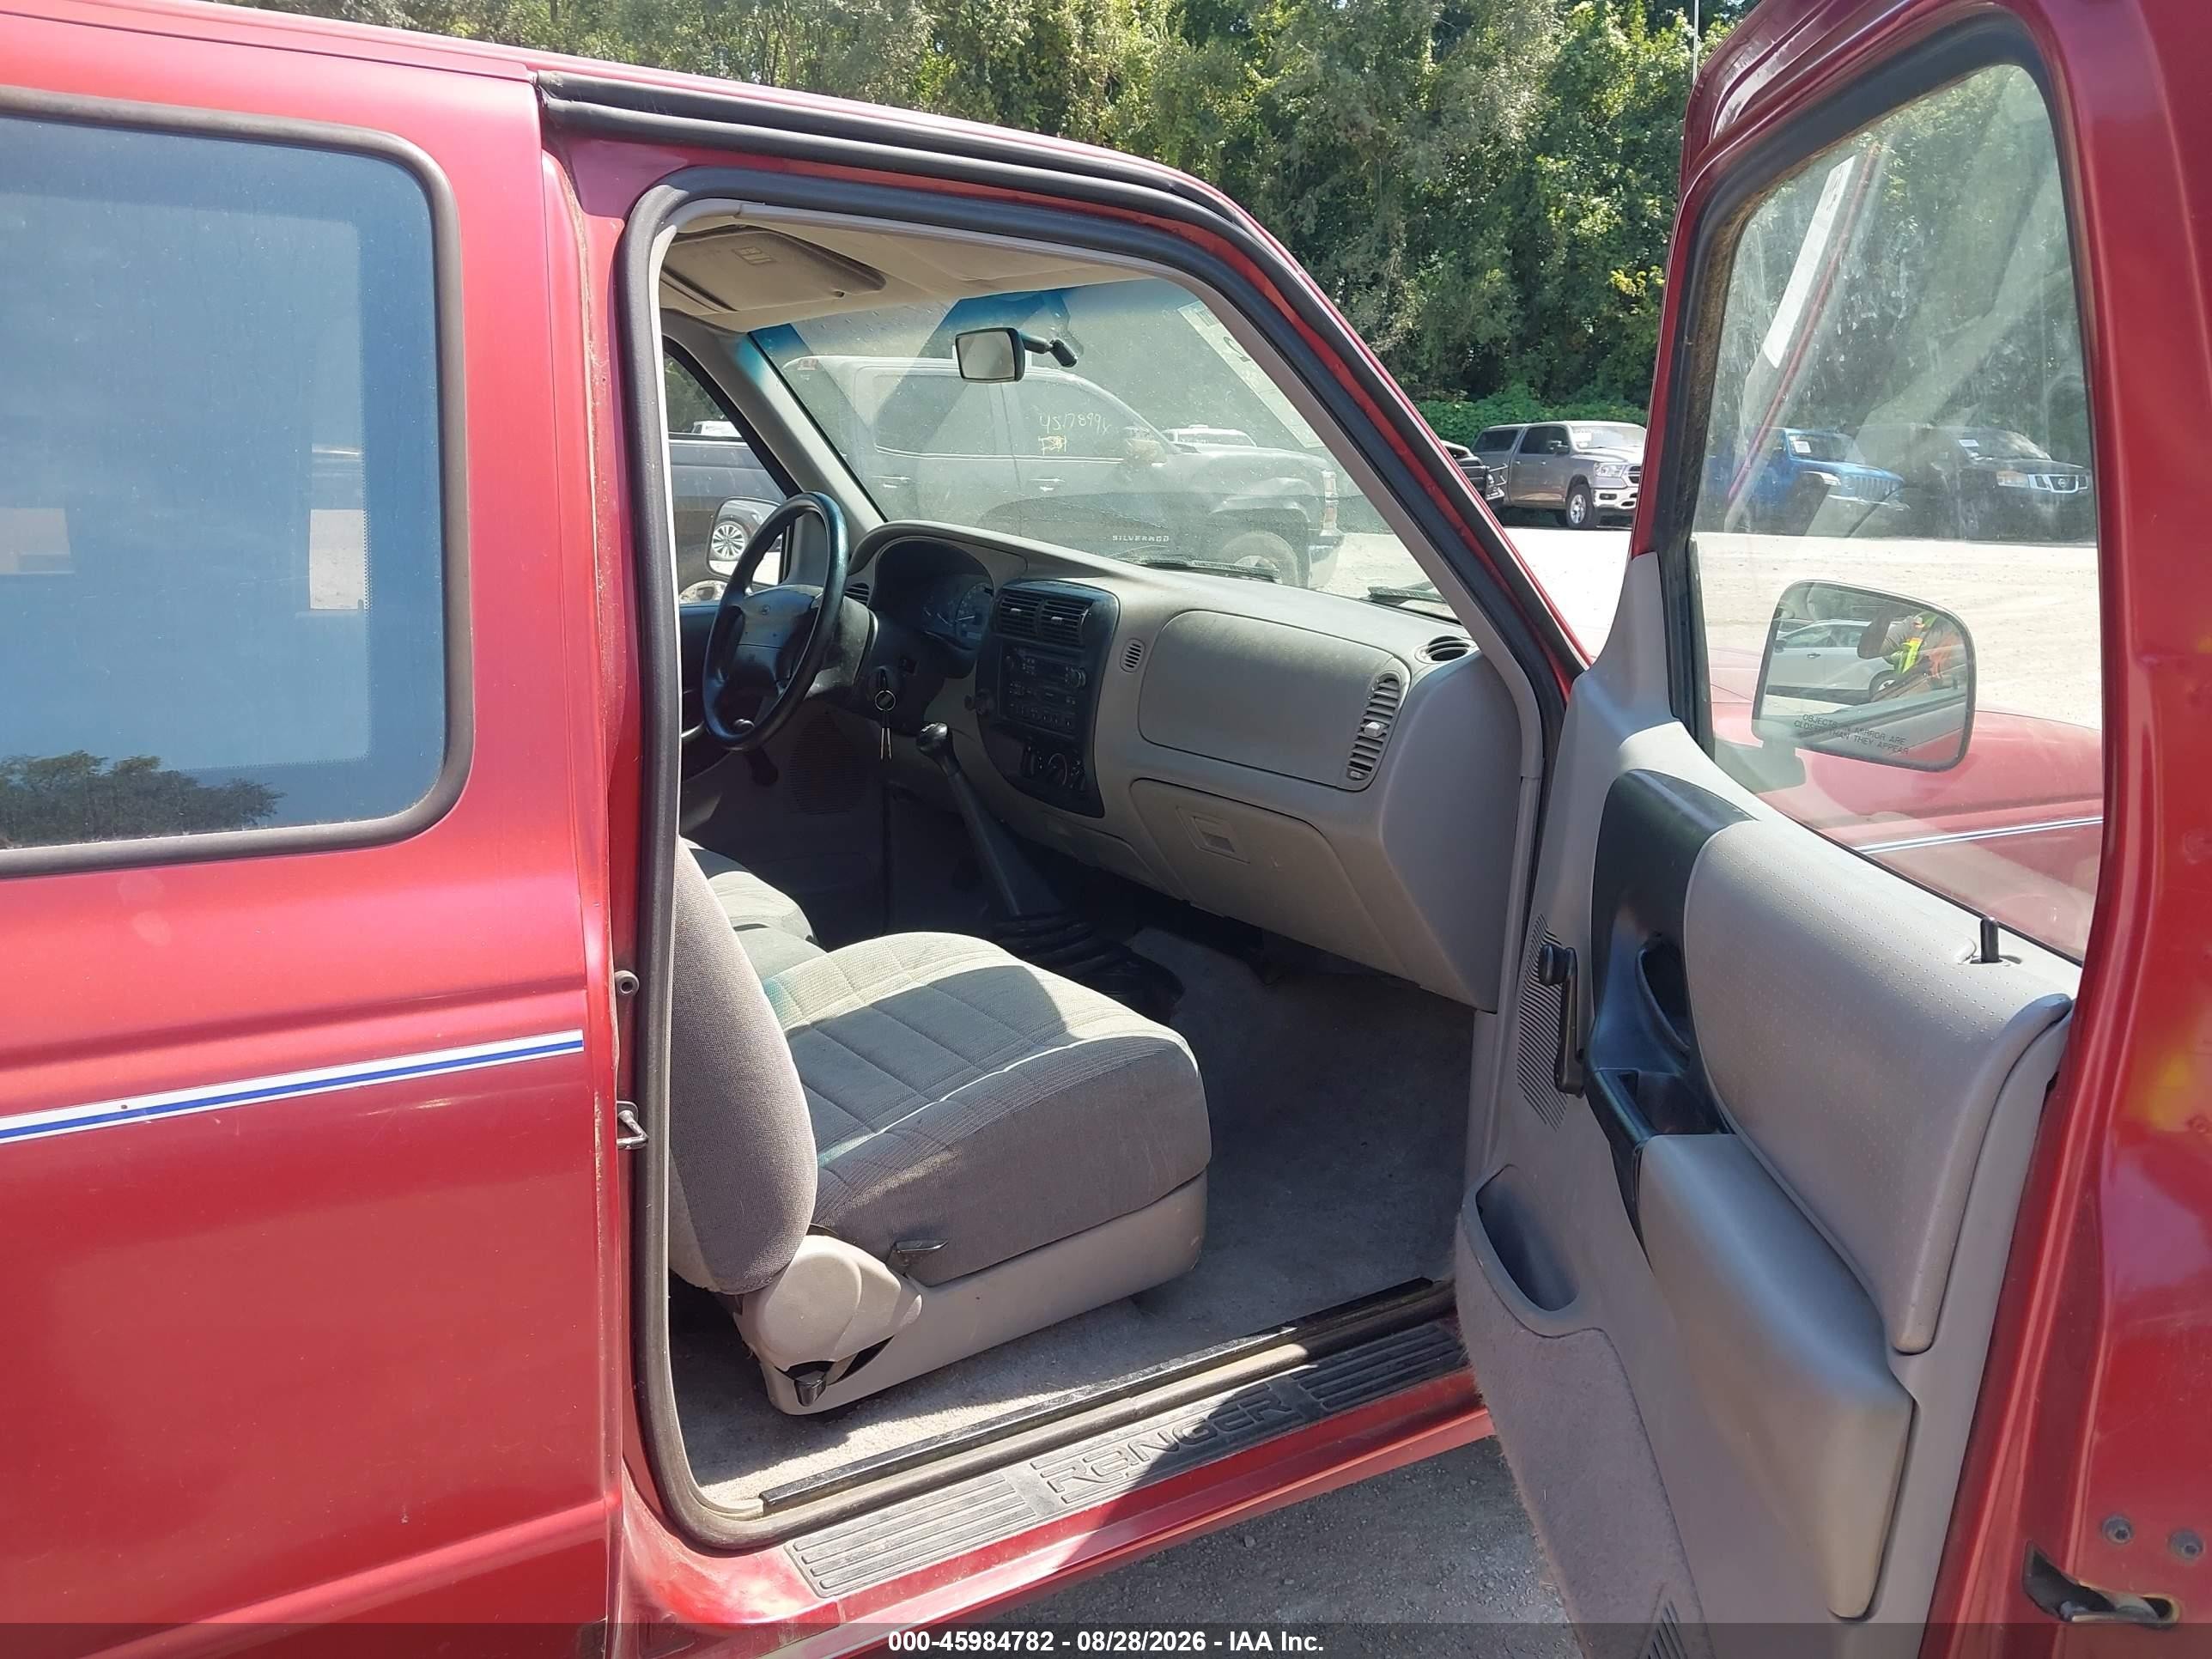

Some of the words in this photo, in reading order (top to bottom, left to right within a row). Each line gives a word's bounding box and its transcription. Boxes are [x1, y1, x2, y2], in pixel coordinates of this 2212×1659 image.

[1802, 714, 1838, 729] OBJECTS
[1855, 727, 1886, 741] MIRROR
[1889, 736, 1906, 746] ARE
[1828, 729, 1850, 741] THAN
[1854, 735, 1874, 746] THEY
[1877, 741, 1910, 755] APPEAR
[1040, 1390, 1292, 1493] RANGER
